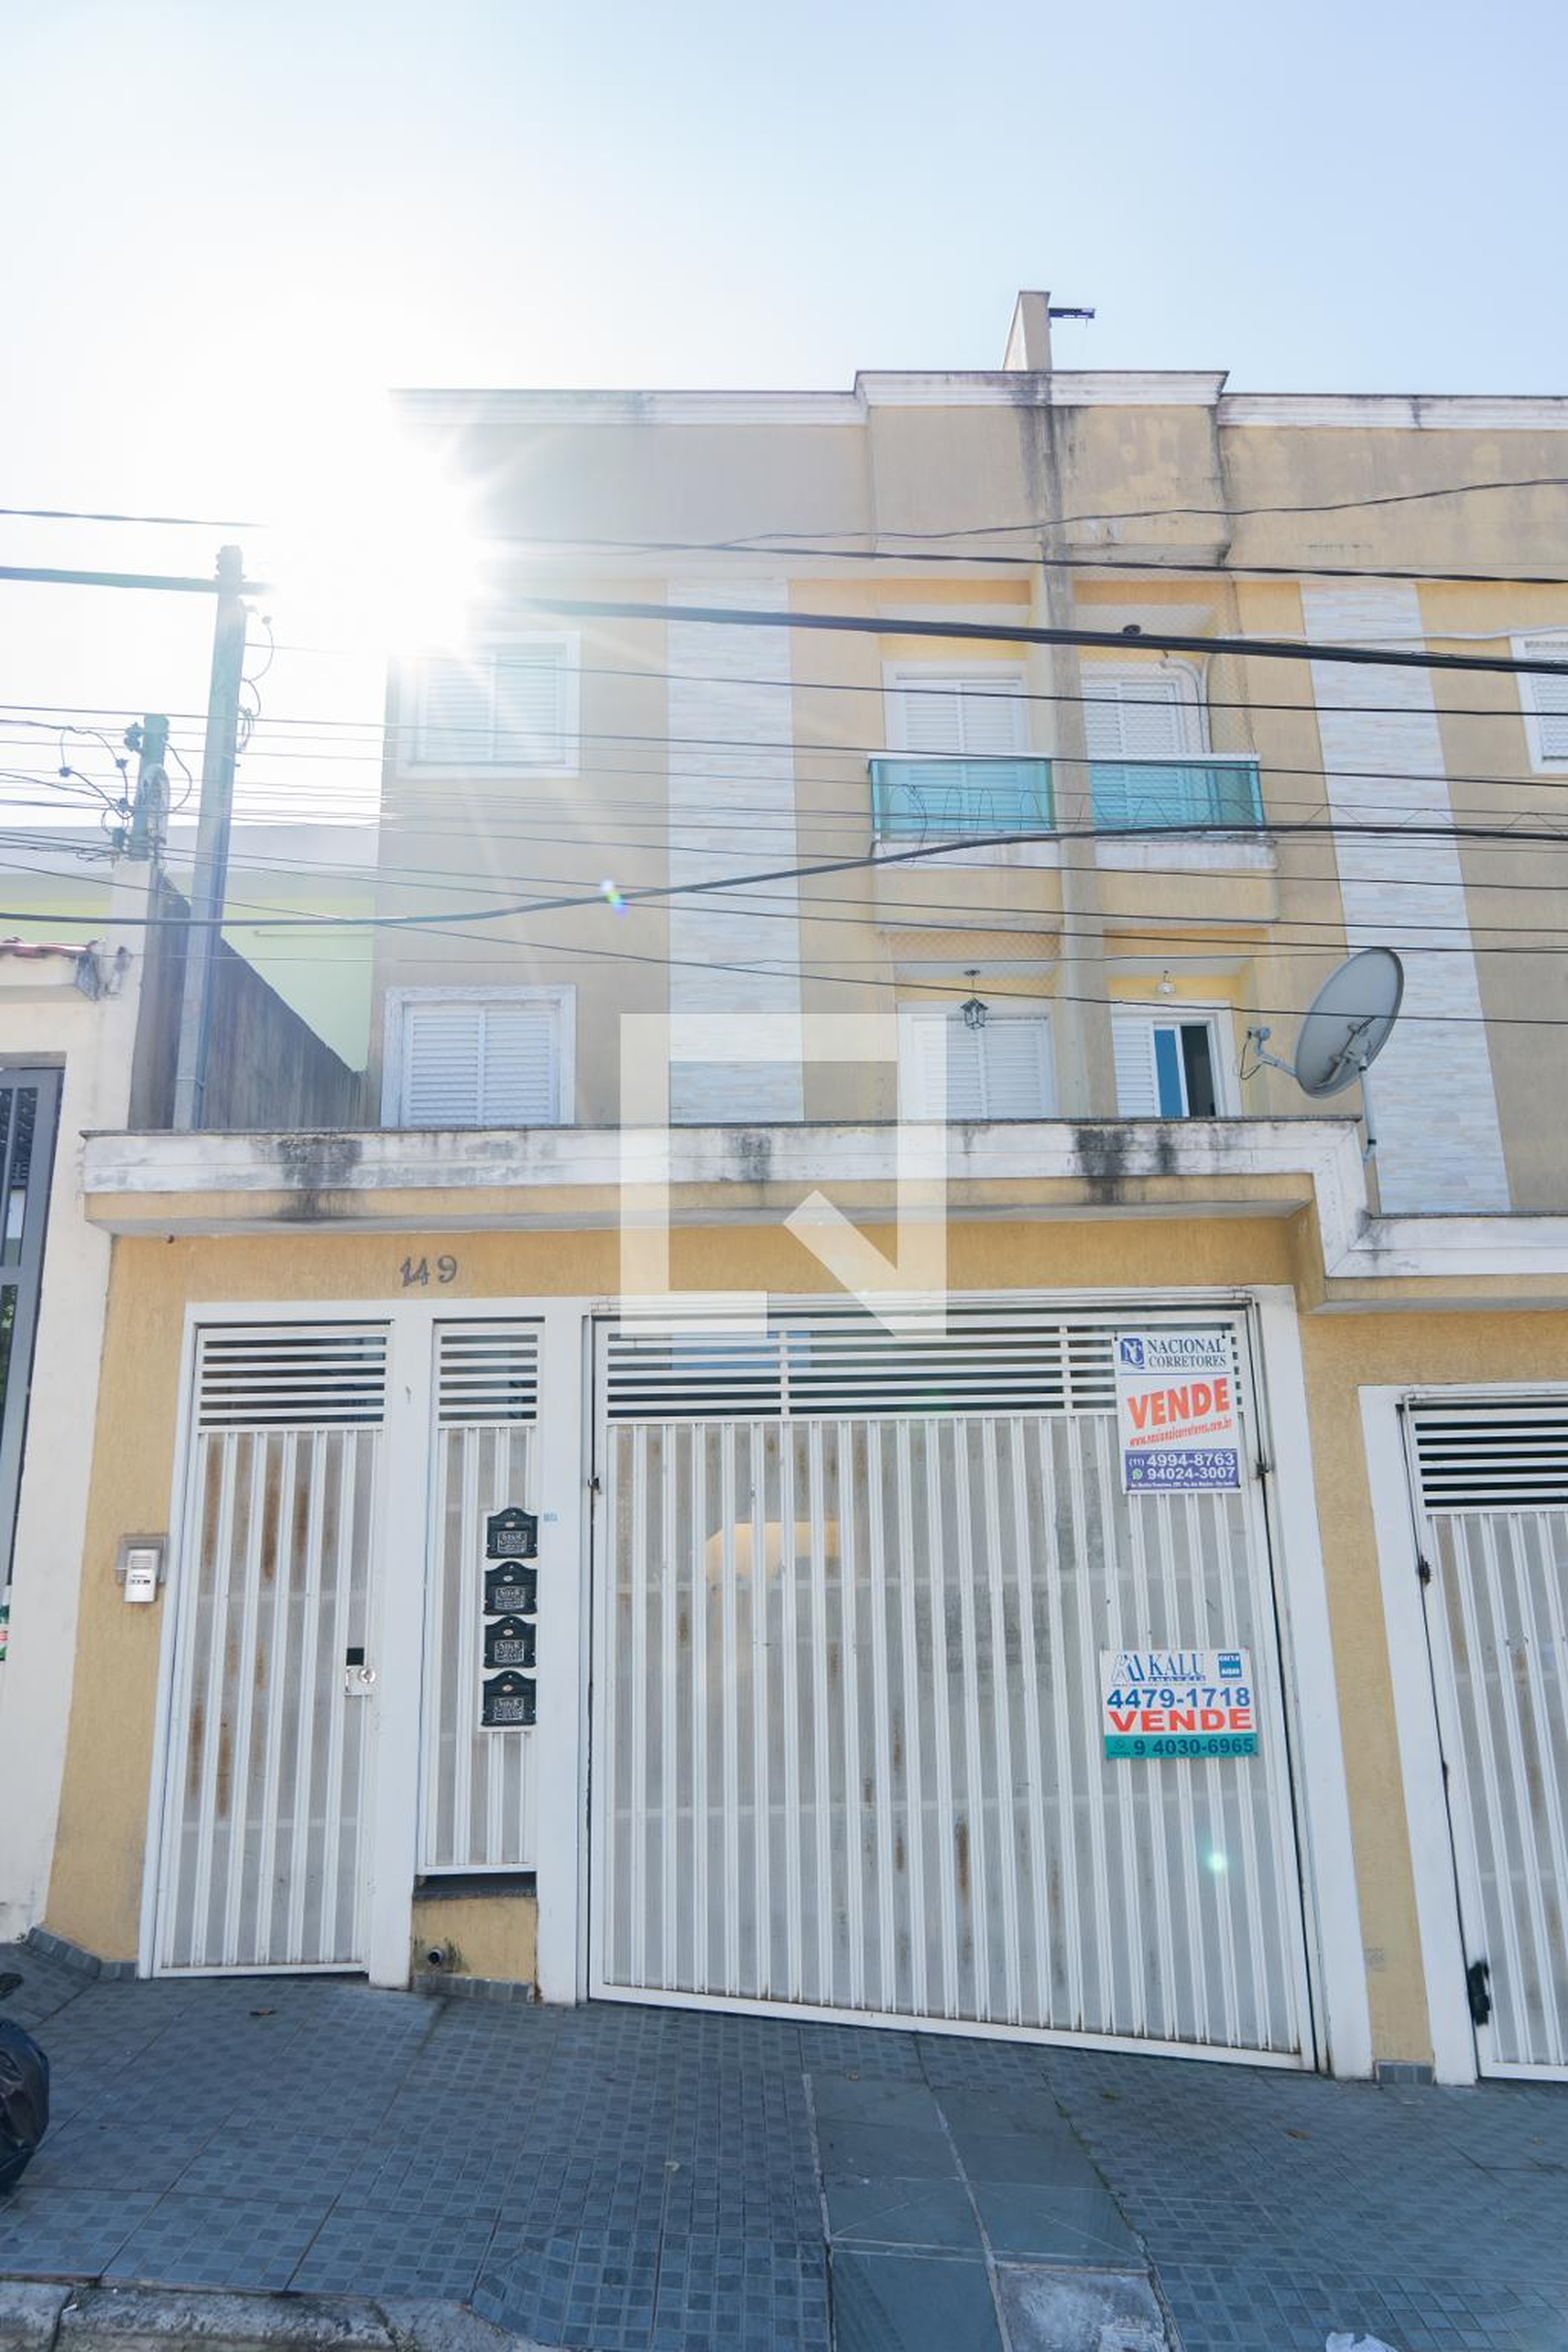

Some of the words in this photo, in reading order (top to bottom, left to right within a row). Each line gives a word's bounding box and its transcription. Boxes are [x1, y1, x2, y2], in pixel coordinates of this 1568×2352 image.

[400, 1255, 457, 1287] 149
[1147, 1339, 1225, 1354] NACIONAL
[1149, 1355, 1226, 1367] CORRETORES
[1127, 1377, 1229, 1430] VENDE
[1129, 1458, 1145, 1467] (11)
[1147, 1453, 1234, 1467] 4994-8763
[1147, 1467, 1235, 1480] 94024-3007
[1107, 1687, 1250, 1709] 4479-1718
[1108, 1708, 1252, 1732] VENDE
[1134, 1740, 1145, 1755] 9
[1153, 1738, 1254, 1755] 4030-6965
